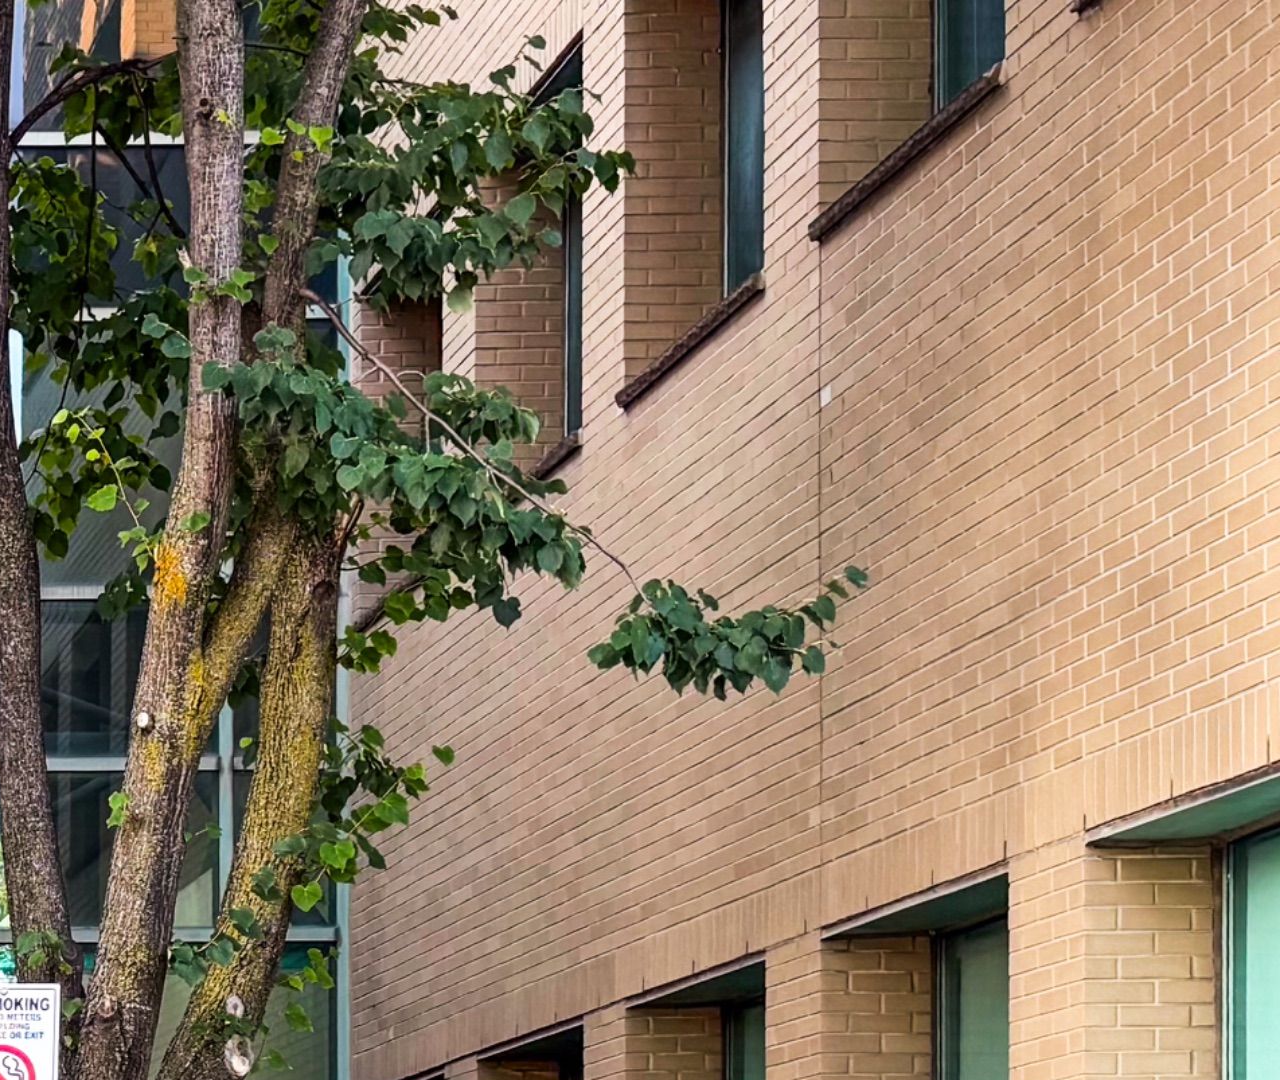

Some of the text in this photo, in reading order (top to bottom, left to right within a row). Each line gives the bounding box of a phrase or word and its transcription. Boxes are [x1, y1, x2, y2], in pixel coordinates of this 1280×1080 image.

[7, 1013, 42, 1021] METERS
[9, 1031, 22, 1039] OR
[24, 1031, 44, 1039] EXIT
